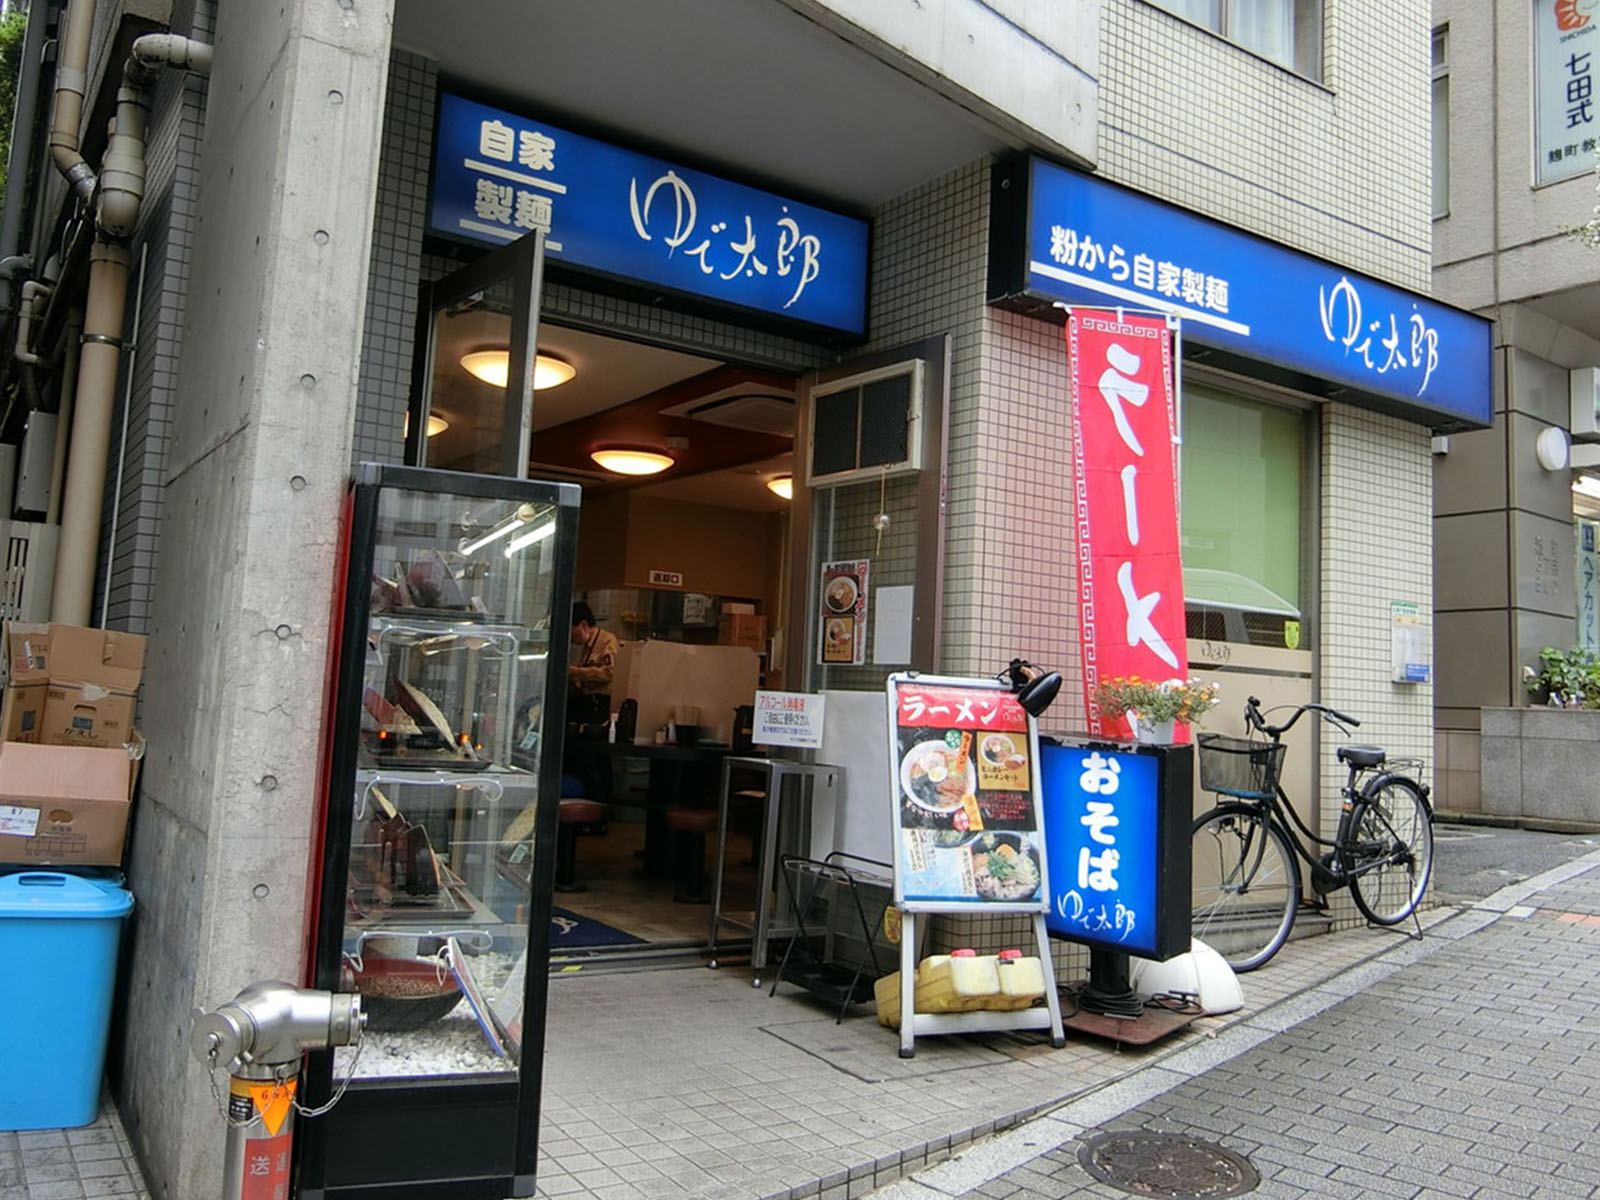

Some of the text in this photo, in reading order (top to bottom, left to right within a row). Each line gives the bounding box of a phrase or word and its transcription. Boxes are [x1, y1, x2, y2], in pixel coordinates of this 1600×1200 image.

[1565, 52, 1594, 130] 七田式
[479, 120, 556, 172] 自家
[1548, 136, 1600, 165] 麹町教
[474, 178, 552, 234] 製麺
[629, 170, 821, 309] ゆで太郎
[1050, 224, 1230, 314] 粉から自家製麺
[1319, 276, 1439, 396] ゆで太郎
[902, 694, 998, 726] ラーメン
[1077, 751, 1122, 892] おそば
[1057, 889, 1136, 943] ゆで太郎
[249, 1155, 270, 1176] 送
